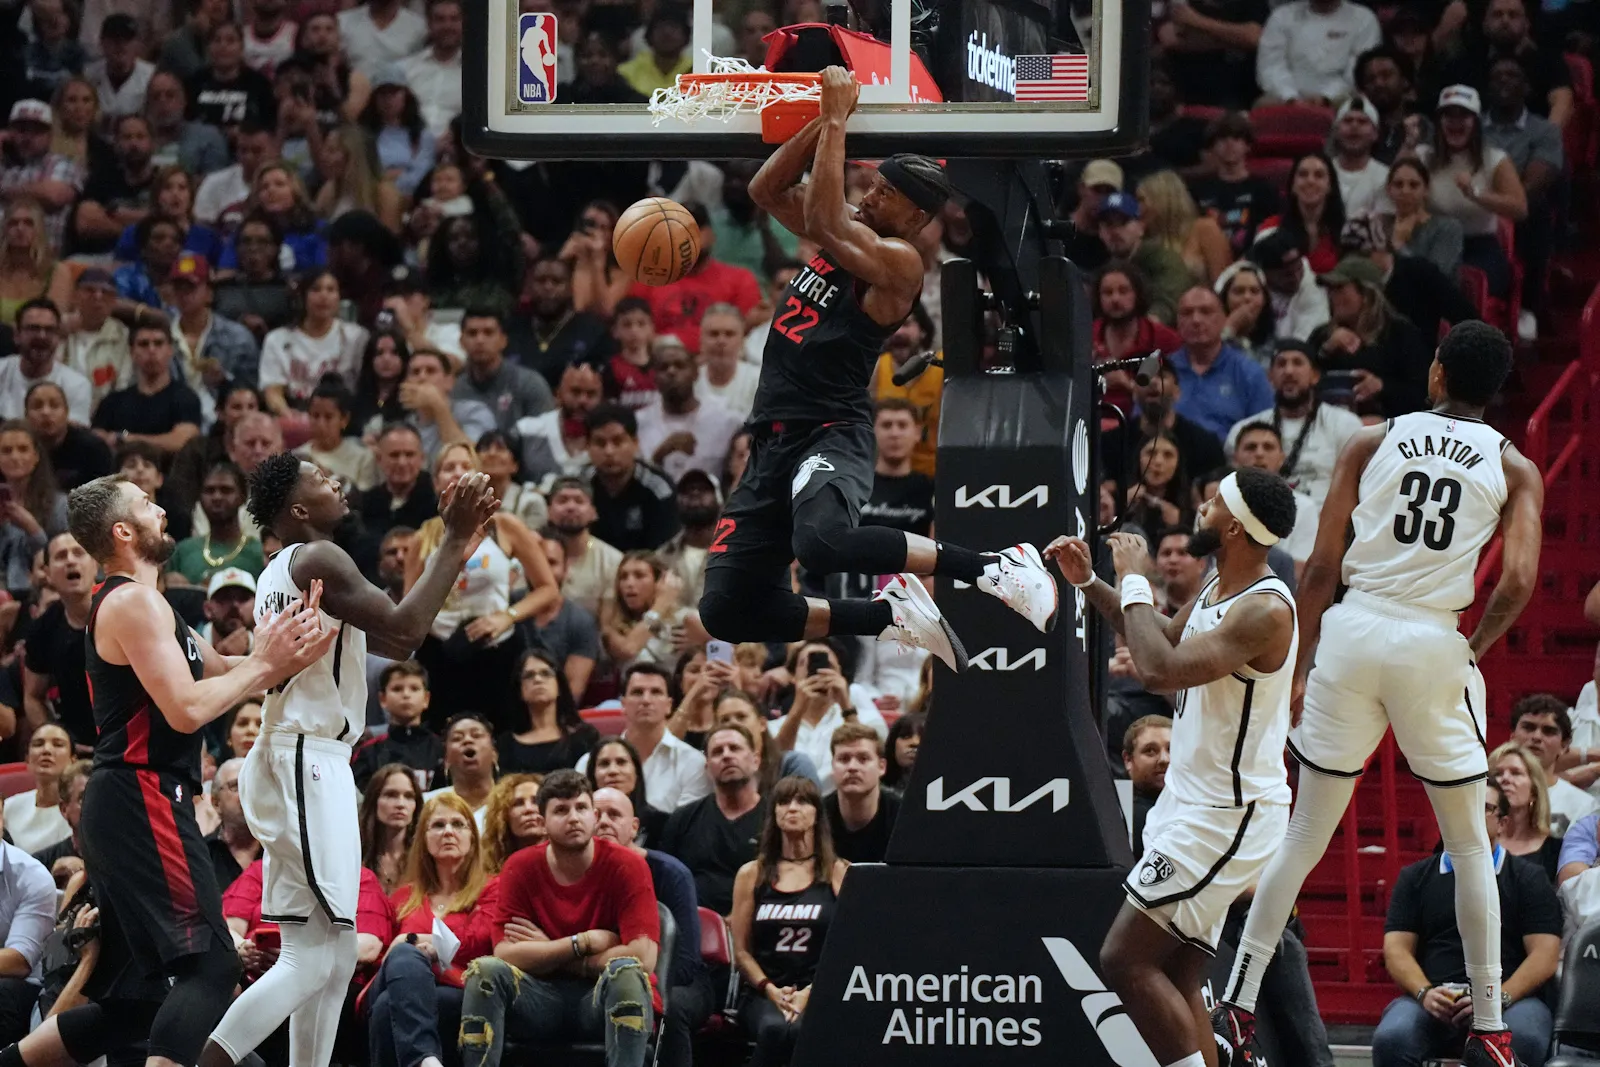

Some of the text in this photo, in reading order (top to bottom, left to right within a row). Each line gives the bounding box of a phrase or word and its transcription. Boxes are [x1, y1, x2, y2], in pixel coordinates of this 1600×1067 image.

[523, 83, 542, 98] NBA
[790, 266, 839, 308] TURE
[773, 295, 819, 345] 22
[1398, 435, 1484, 470] CLAXTON
[955, 484, 1048, 508] KIA
[1393, 471, 1462, 551] 33
[709, 517, 737, 553] 2
[1074, 506, 1086, 653] A&T
[926, 776, 1070, 813] KIA
[1147, 851, 1173, 879] NETS
[756, 903, 822, 921] MIAMI
[775, 927, 812, 952] 22
[842, 965, 1042, 1004] American
[882, 1008, 1041, 1047] Airlines
